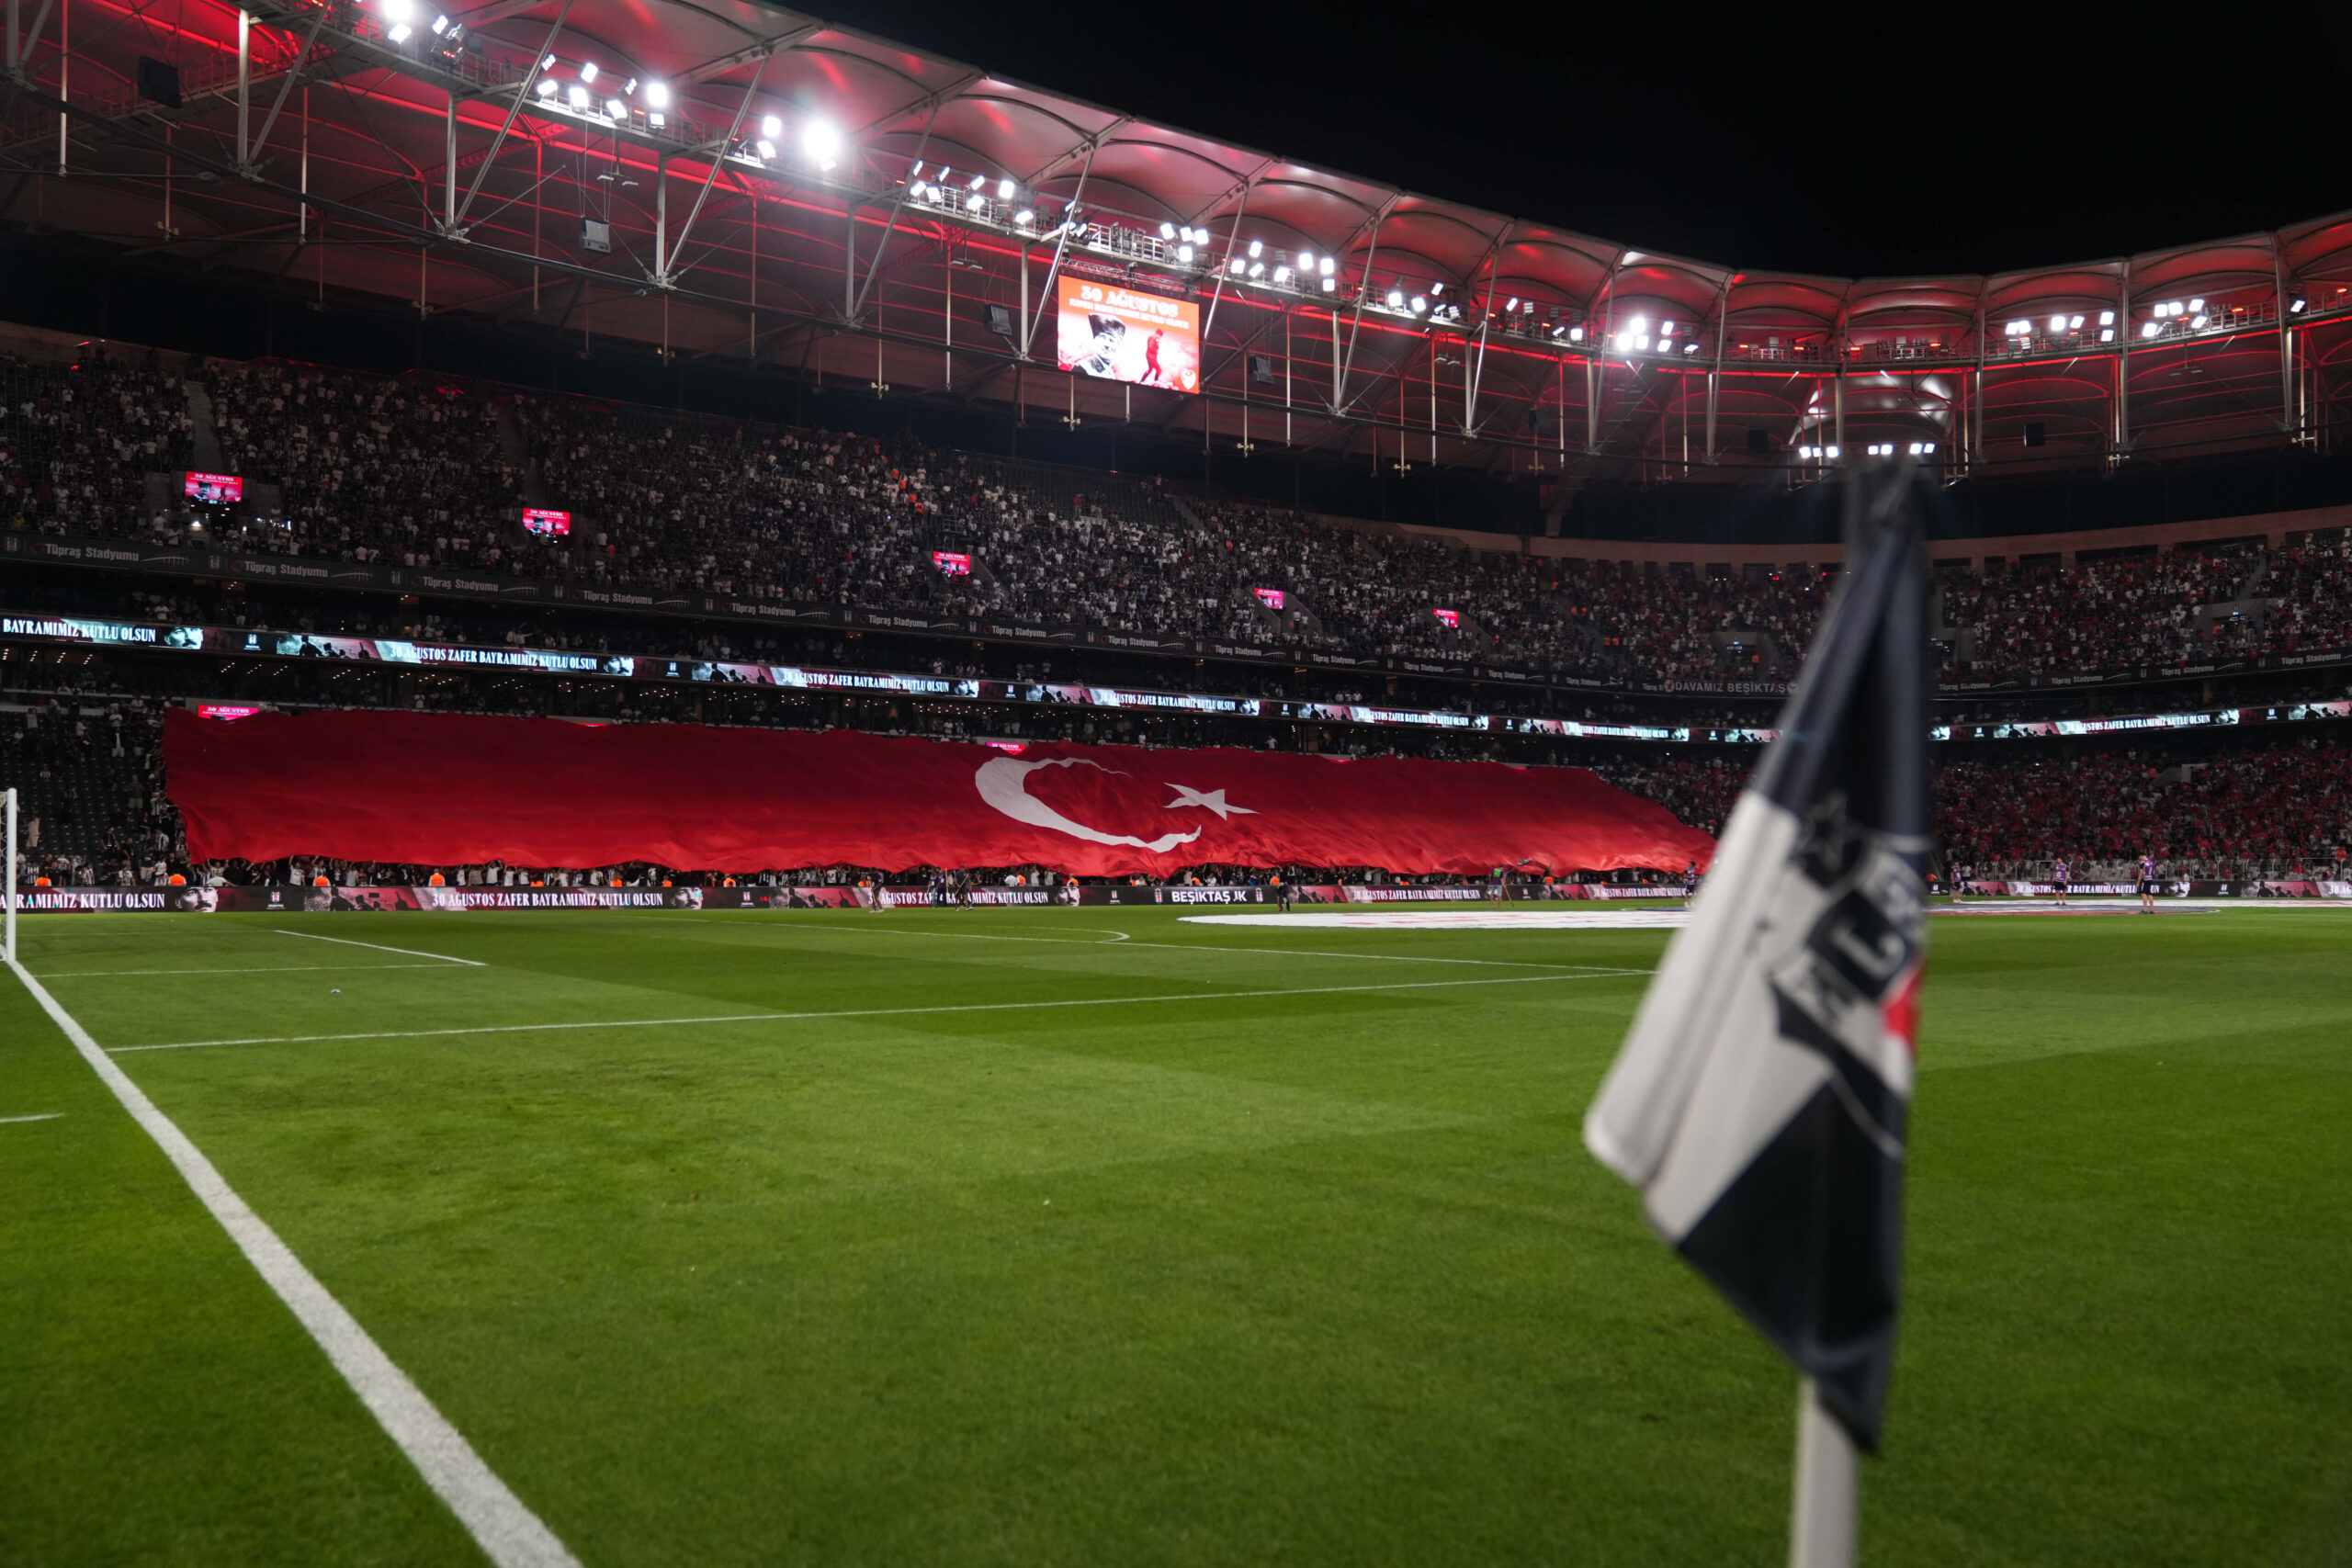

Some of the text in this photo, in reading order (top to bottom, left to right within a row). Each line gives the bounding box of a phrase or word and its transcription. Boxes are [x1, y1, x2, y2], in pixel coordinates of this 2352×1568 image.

[1081, 285, 1178, 317] 30 AĞUSTOS
[46, 543, 139, 562] Tüpraş Stadyumu
[244, 560, 328, 577] Tüpraş Stadyumu
[423, 576, 498, 592] Tüpraş Stadyumu
[582, 590, 652, 605] Tüpraş Stadyumu
[731, 603, 796, 616] Tüpraş Stadyumu
[869, 615, 927, 628] Tüpraş Stadyumu
[4, 619, 156, 644] BAYRAMIMIZ KUTLU OLSUN
[391, 647, 402, 658] 30
[448, 649, 477, 662] ZAFER
[480, 650, 537, 667] BAYRAMIMIZ
[538, 655, 568, 669] KUTLU
[570, 658, 597, 671] OLSUN
[829, 674, 853, 686] ZAFER
[854, 676, 900, 690] BAYRAMIMIZ
[902, 680, 926, 691] KUTLU
[927, 682, 949, 693] OLSUN
[1676, 682, 1724, 693] DAVAMIZ
[1727, 683, 1785, 694] BEŞİKTAŞ
[1137, 695, 1156, 705] ZAFER
[1217, 700, 1235, 711] OLSUN
[2104, 720, 2124, 729] ZAFER
[2167, 716, 2188, 726] KUTLU
[2190, 715, 2211, 724] OLSUN
[998, 892, 1023, 903] KUTLU
[1024, 892, 1048, 903] OLSUN
[1171, 890, 1247, 904] BEŞİKTAŞ JK
[1389, 891, 1408, 900] ZAFER
[1464, 891, 1480, 899] OLSUN
[2073, 886, 2115, 894] BAYRAMIMIZ
[2329, 886, 2339, 895] 30
[81, 893, 121, 908] KUTLU
[127, 893, 165, 908] OLSUN
[432, 891, 663, 906] 30 AĞUSTOS ZAFER BAYRAMIMIZ KUTLU OLSUN
